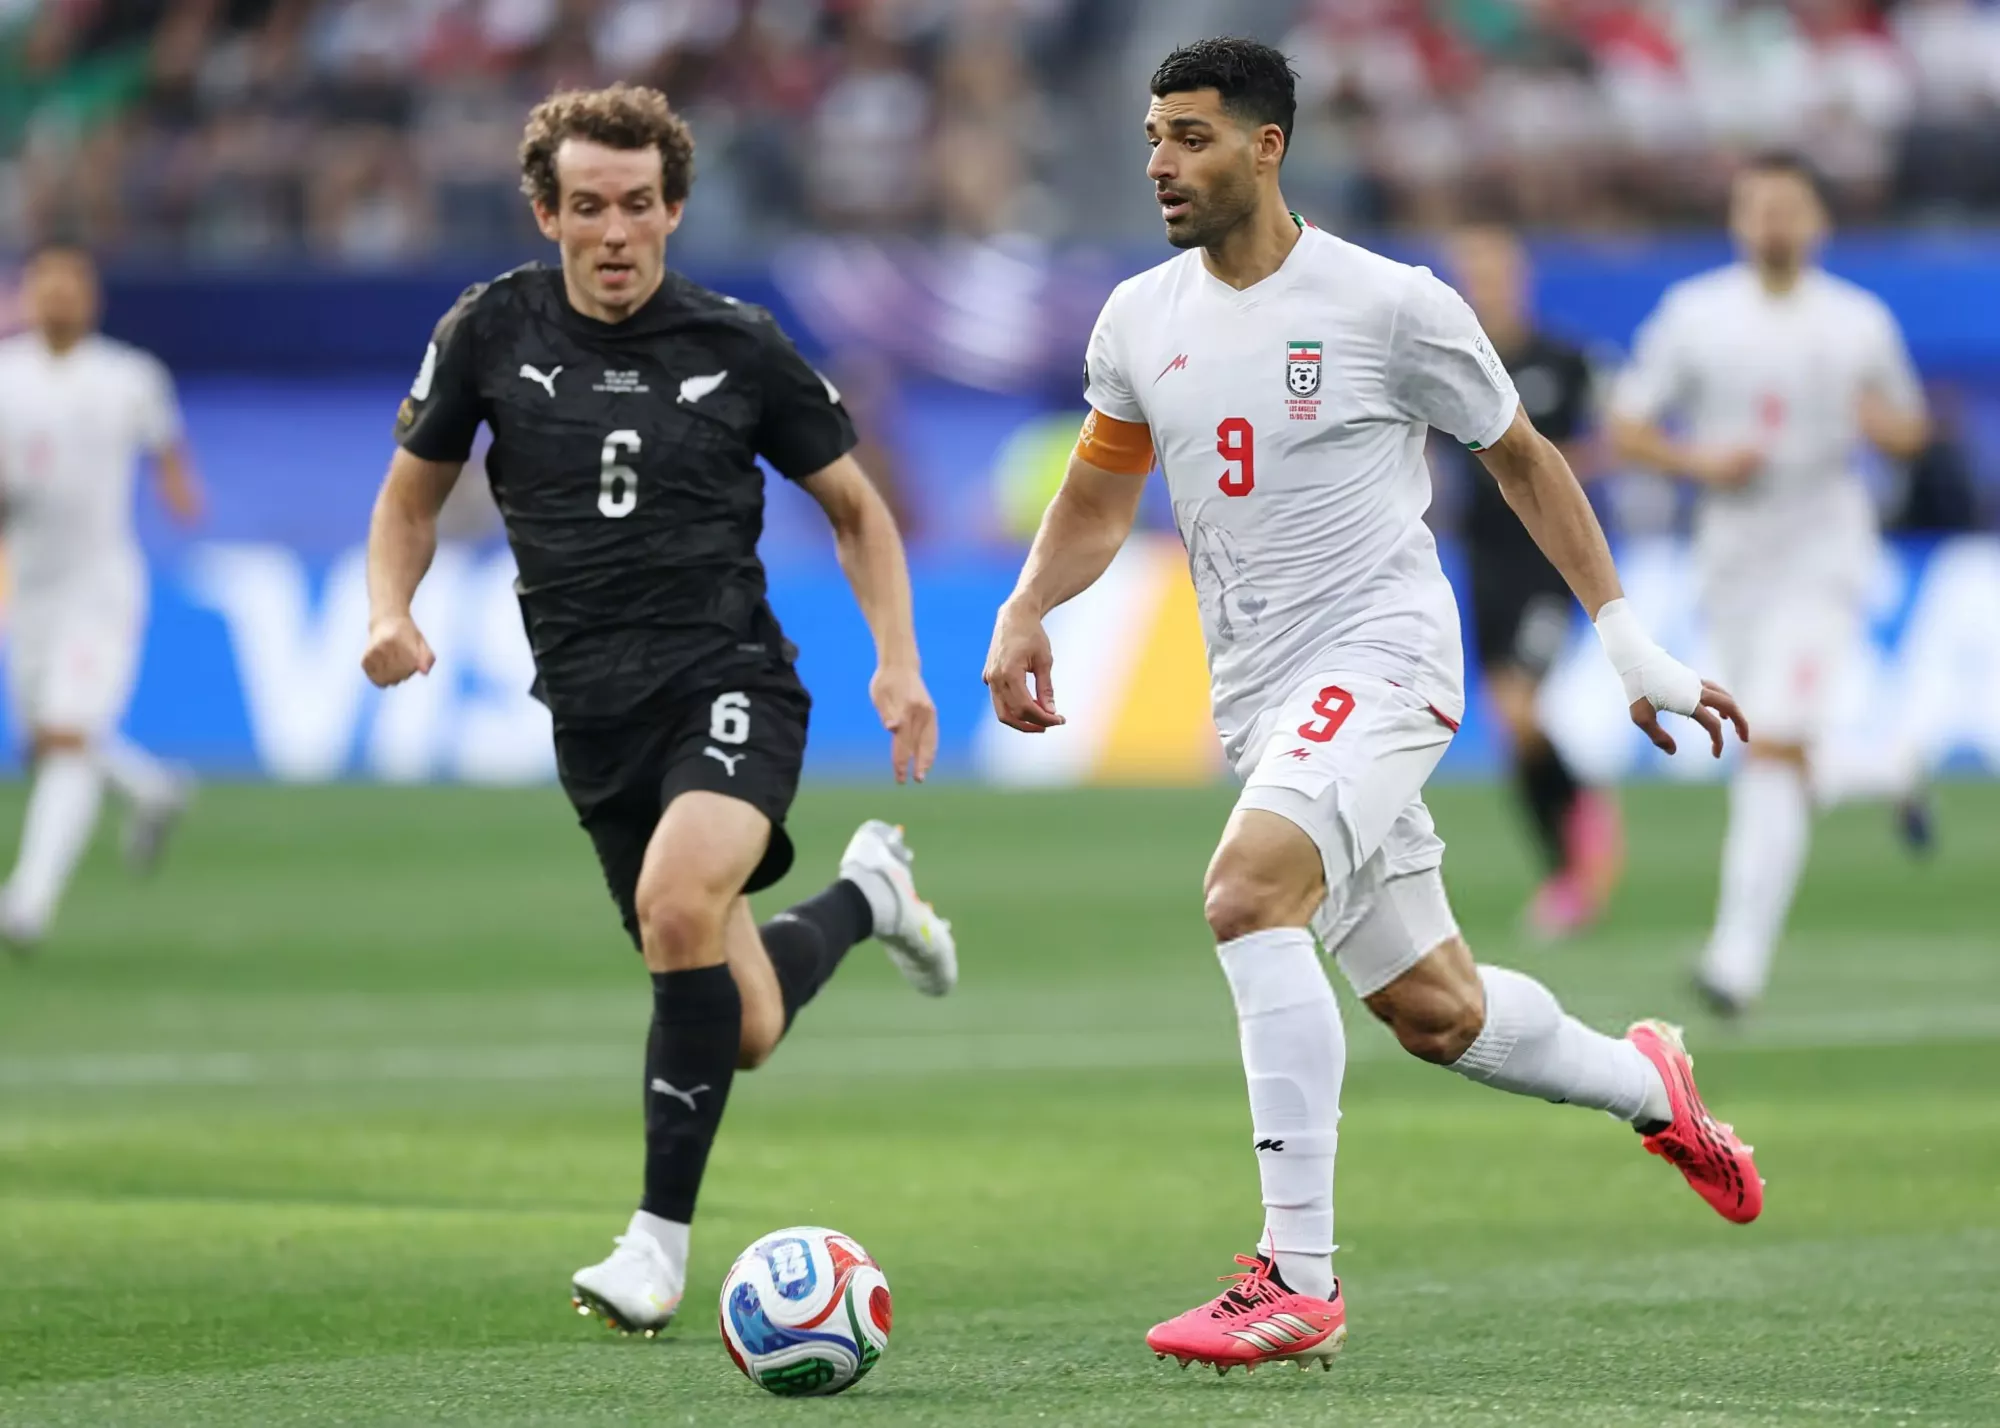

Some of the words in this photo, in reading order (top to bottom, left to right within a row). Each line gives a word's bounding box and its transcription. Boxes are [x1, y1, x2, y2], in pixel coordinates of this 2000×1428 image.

[597, 429, 641, 518] 6
[1216, 417, 1255, 497] 9
[710, 691, 750, 745] 6
[1297, 685, 1356, 743] 9
